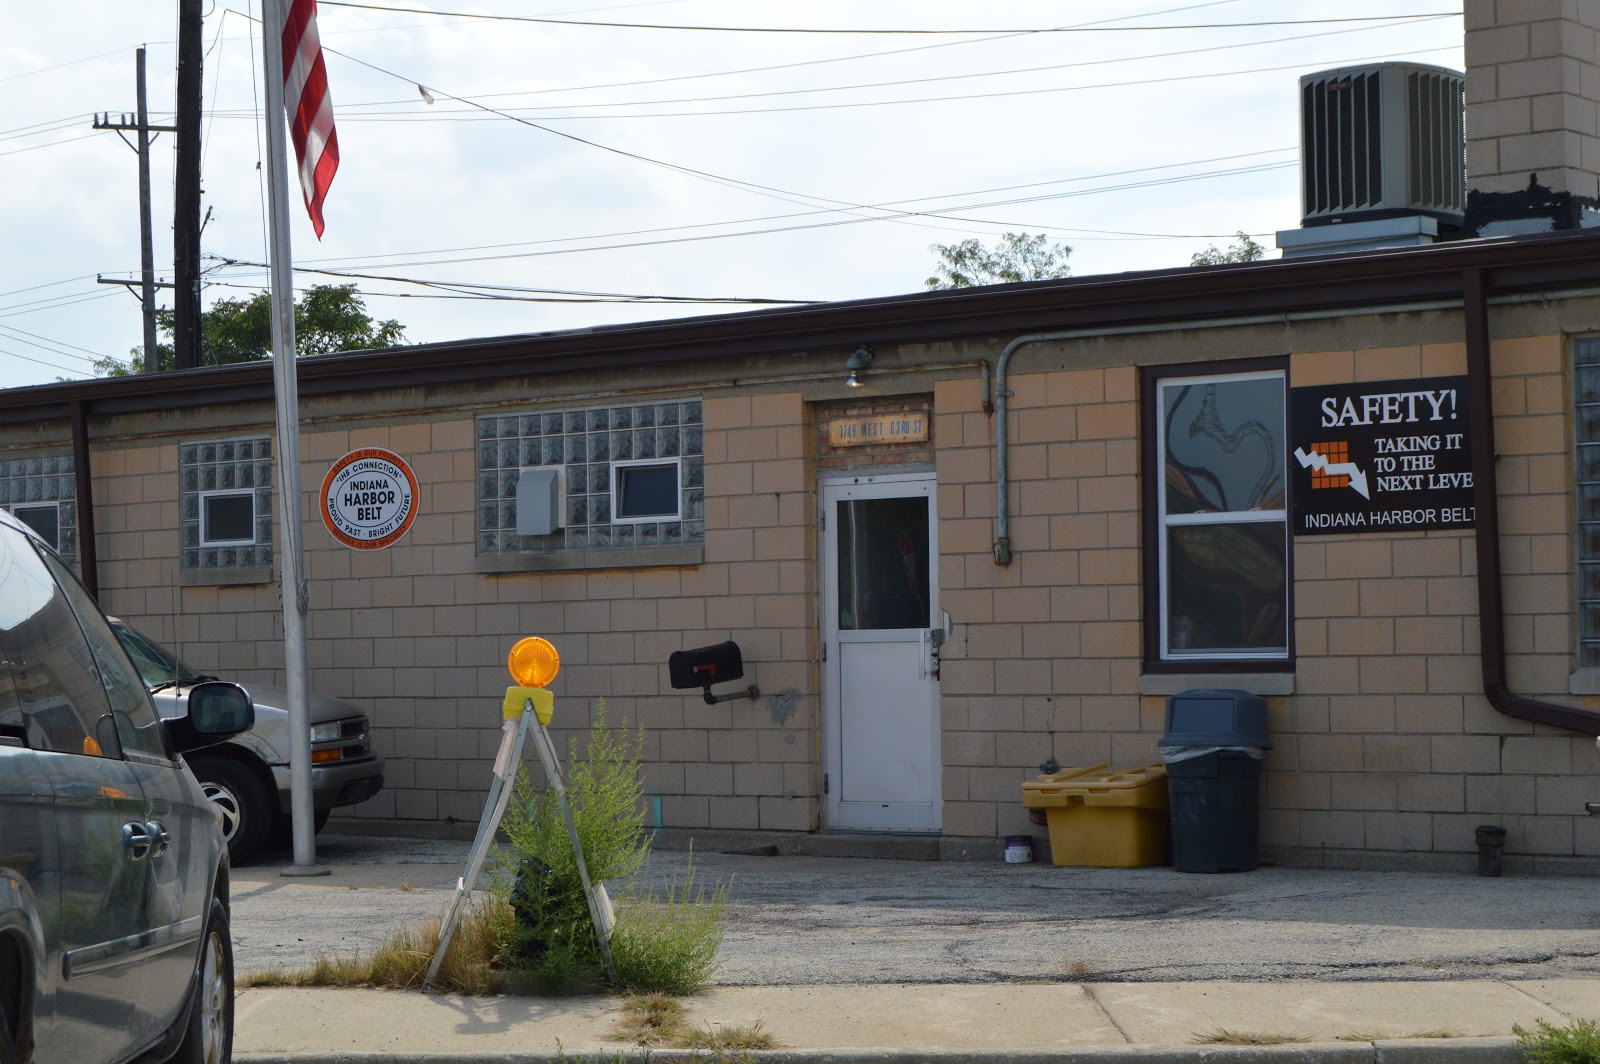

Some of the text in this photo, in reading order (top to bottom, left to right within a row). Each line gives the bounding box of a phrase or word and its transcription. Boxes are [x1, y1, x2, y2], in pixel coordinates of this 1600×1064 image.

[1321, 389, 1457, 428] SAFETY!
[861, 422, 883, 436] WEST
[890, 420, 910, 435] 63RD
[913, 419, 923, 434] ST
[1374, 433, 1463, 453] TAKING IT
[332, 454, 354, 474] SAFETY
[378, 450, 405, 468] PRIORITY
[1374, 455, 1435, 473] TO THE
[350, 479, 389, 492] INDIANA
[1376, 472, 1474, 492] NEXT LEVE
[344, 490, 395, 507] HARBOR
[328, 498, 343, 526] PROUD
[344, 525, 361, 537] PAST
[368, 522, 394, 538] BRIGHT
[357, 506, 382, 521] BELT
[1305, 510, 1366, 528] INDIANA
[1370, 508, 1437, 526] HARBOR
[332, 527, 355, 547] SERVICE
[378, 524, 407, 547] SPECIALTY
